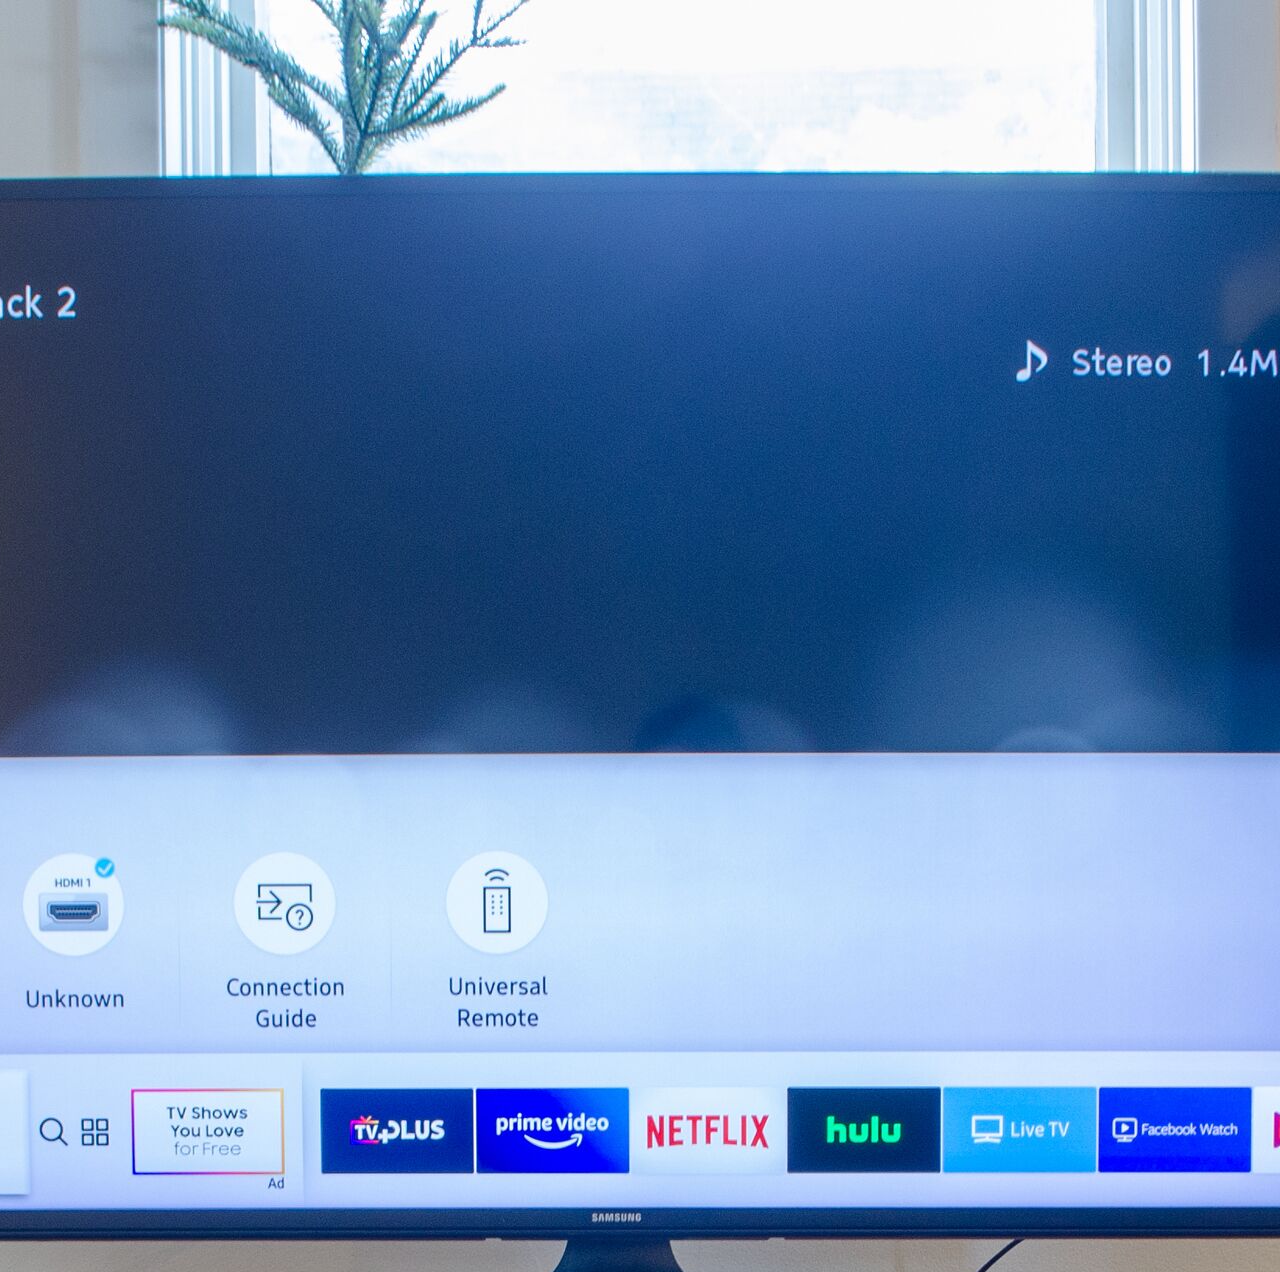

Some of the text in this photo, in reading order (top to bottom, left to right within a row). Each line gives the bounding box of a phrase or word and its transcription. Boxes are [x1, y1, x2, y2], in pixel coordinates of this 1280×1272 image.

[57, 286, 77, 318] 2
[1073, 346, 1172, 377] Stereo
[54, 878, 91, 889] HDMI 1
[226, 977, 345, 997] Connection
[448, 976, 549, 996] Universal
[25, 989, 125, 1009] Unknown
[255, 1009, 318, 1028] Guide
[457, 1009, 539, 1027] Remote
[166, 1106, 248, 1119] TV Shows
[171, 1124, 245, 1137] You Love
[496, 1112, 609, 1136] prime video
[646, 1115, 769, 1149] NETFLIX
[826, 1116, 902, 1143] hulu
[1010, 1121, 1070, 1137] Live TV
[1141, 1122, 1238, 1136] Facebook Watch
[174, 1142, 241, 1156] for Free
[268, 1177, 285, 1189] Ad
[591, 1212, 642, 1223] SAMSUNG
